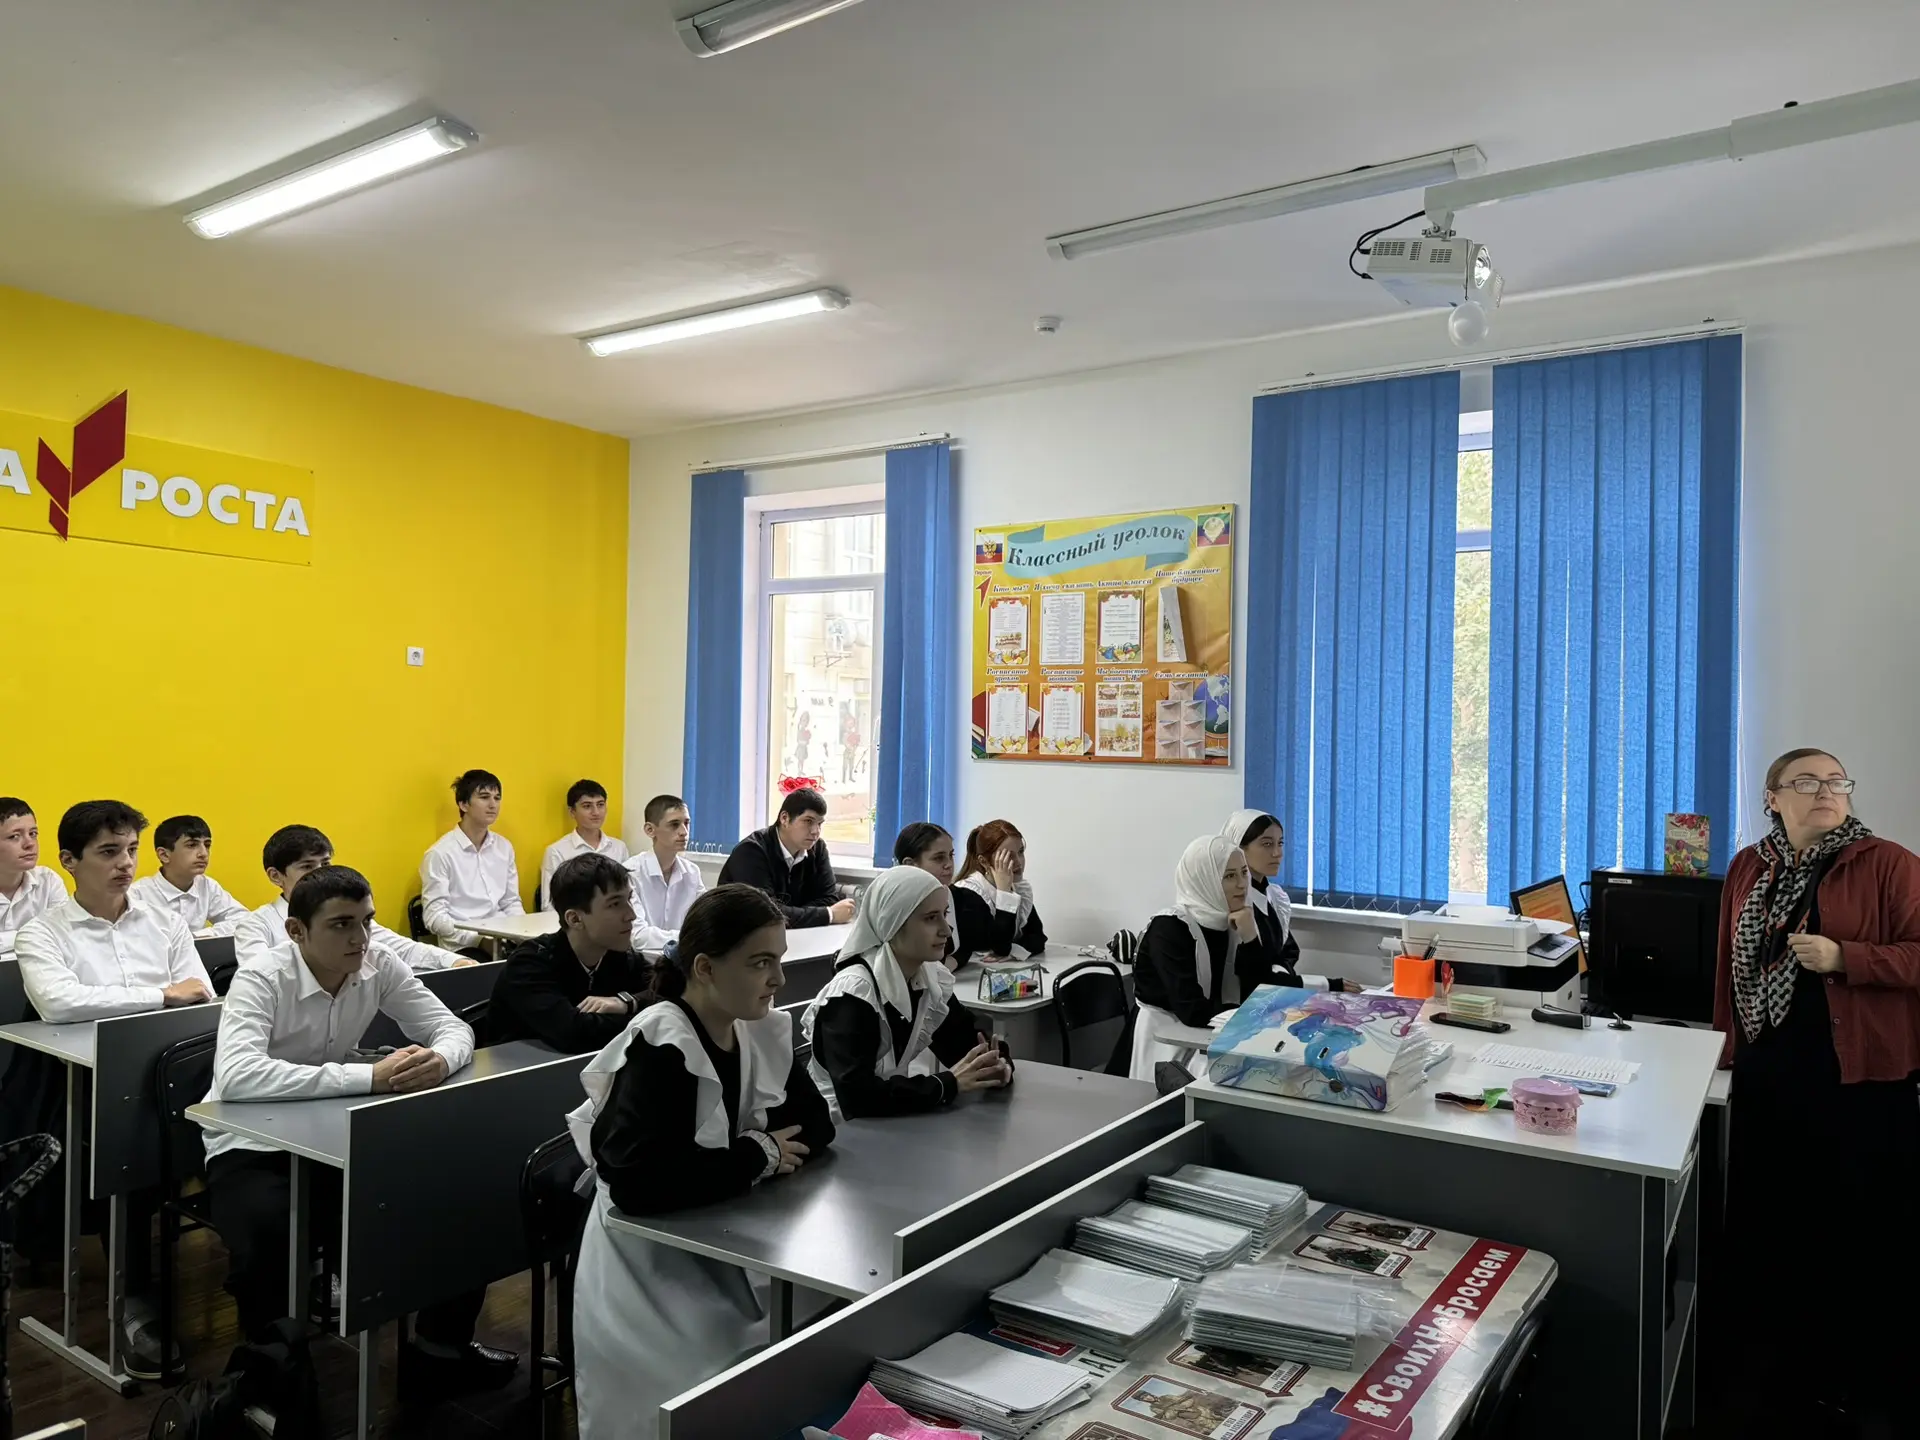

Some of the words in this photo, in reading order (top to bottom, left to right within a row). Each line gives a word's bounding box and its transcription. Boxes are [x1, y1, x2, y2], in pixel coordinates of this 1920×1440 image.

[121, 468, 310, 536] РОСТА
[1008, 532, 1106, 567] Классный
[1113, 526, 1186, 551] уголок
